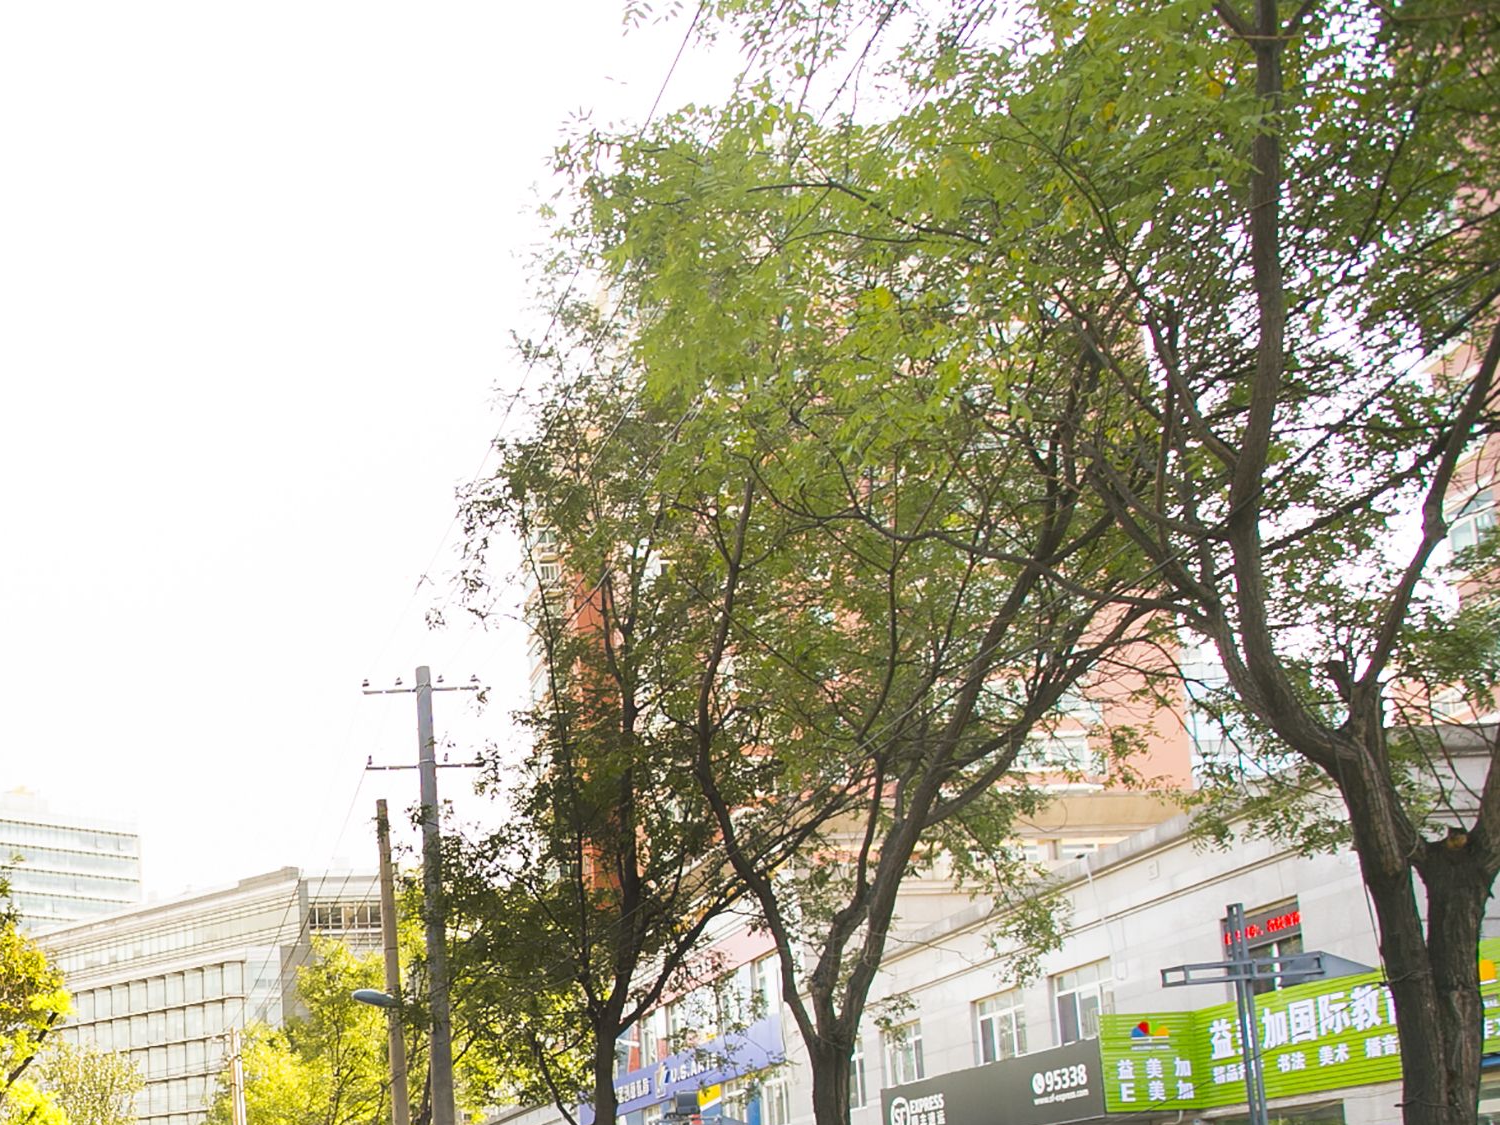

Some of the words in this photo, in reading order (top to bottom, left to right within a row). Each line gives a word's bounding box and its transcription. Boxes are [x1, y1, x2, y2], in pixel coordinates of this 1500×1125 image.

[1117, 1057, 1193, 1080] 益美加
[1277, 1052, 1306, 1073] 书法
[1319, 1043, 1350, 1067] 美术
[1045, 1064, 1088, 1092] 95338
[910, 1093, 945, 1115] EXPRESS
